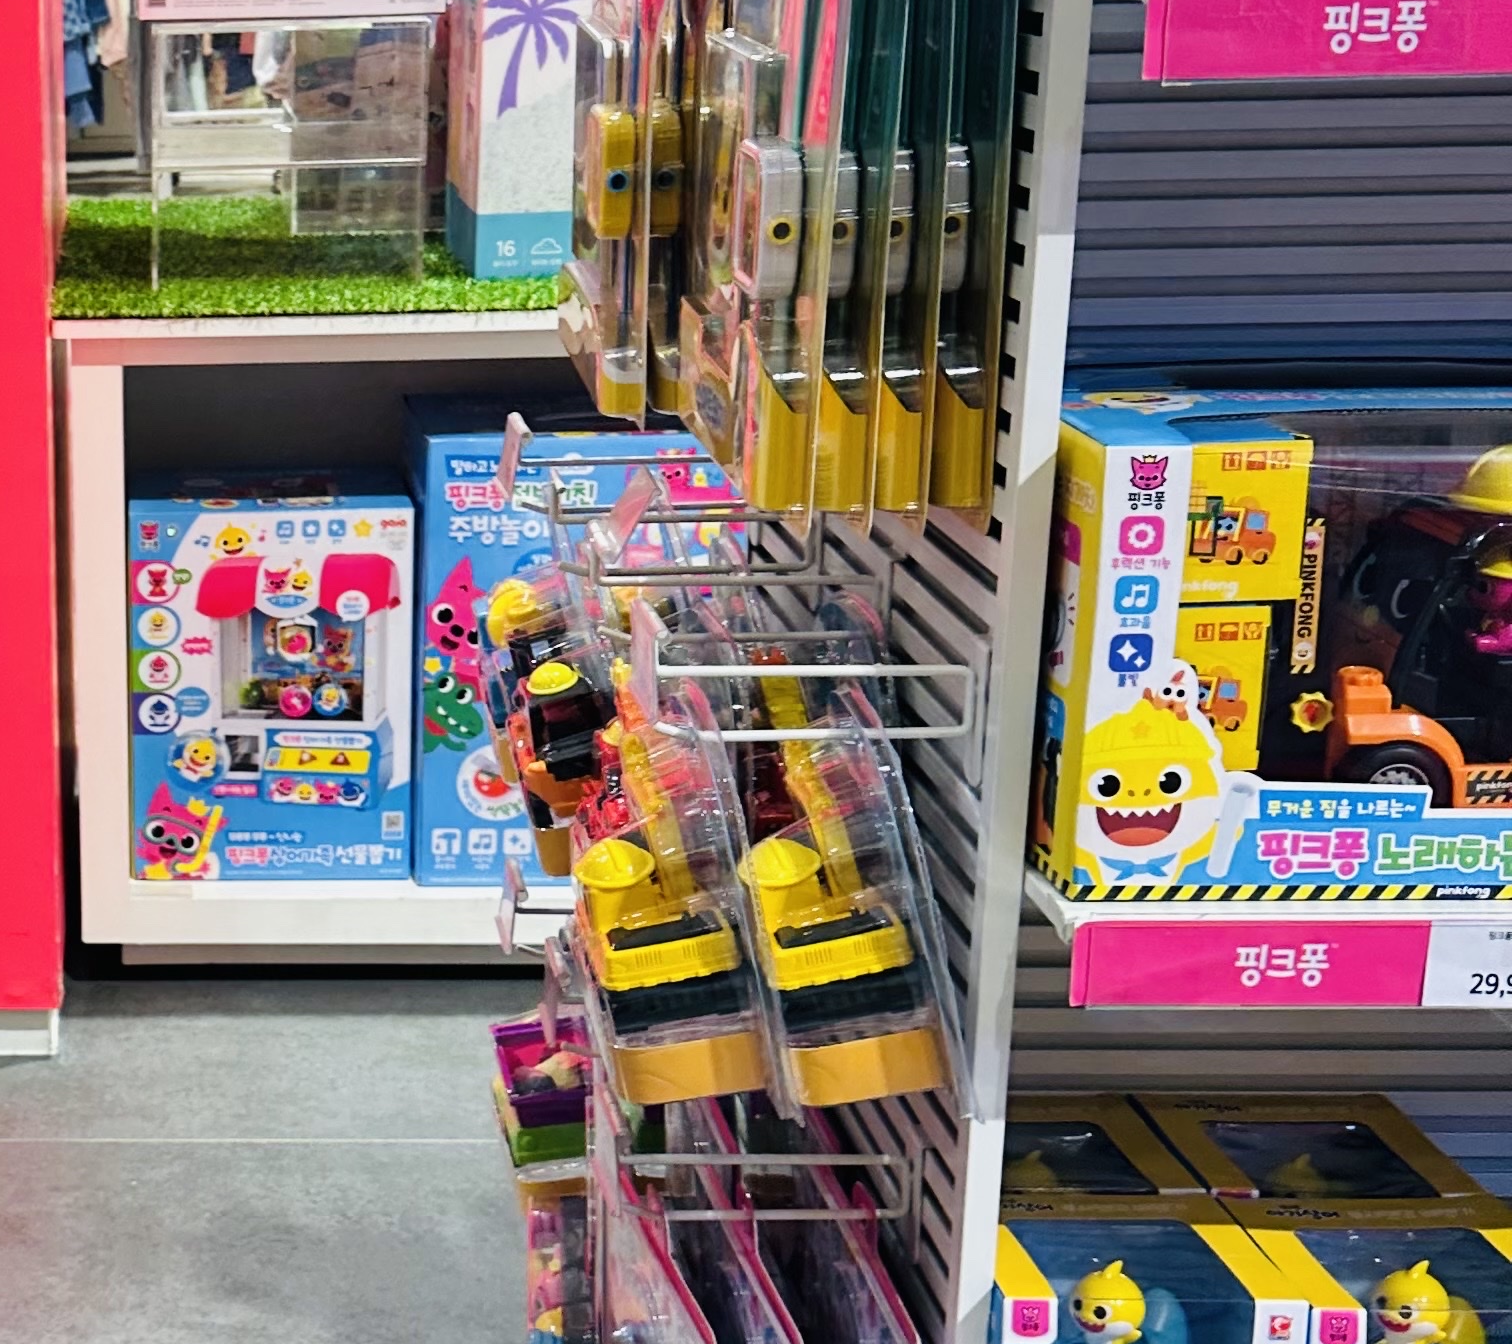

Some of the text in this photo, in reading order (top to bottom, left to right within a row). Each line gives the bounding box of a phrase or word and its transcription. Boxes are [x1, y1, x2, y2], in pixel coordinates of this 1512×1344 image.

[1323, 0, 1428, 54] 핑크퐁
[496, 240, 516, 257] 16
[1127, 491, 1166, 511] 핑크퐁
[1297, 553, 1317, 639] PINKFONG
[1266, 799, 1314, 819] 무거운
[1320, 798, 1352, 819] 짐을
[1259, 830, 1368, 878] 핑크퐁
[1436, 886, 1491, 899] pinkfong
[1235, 943, 1330, 988] 핑크퐁
